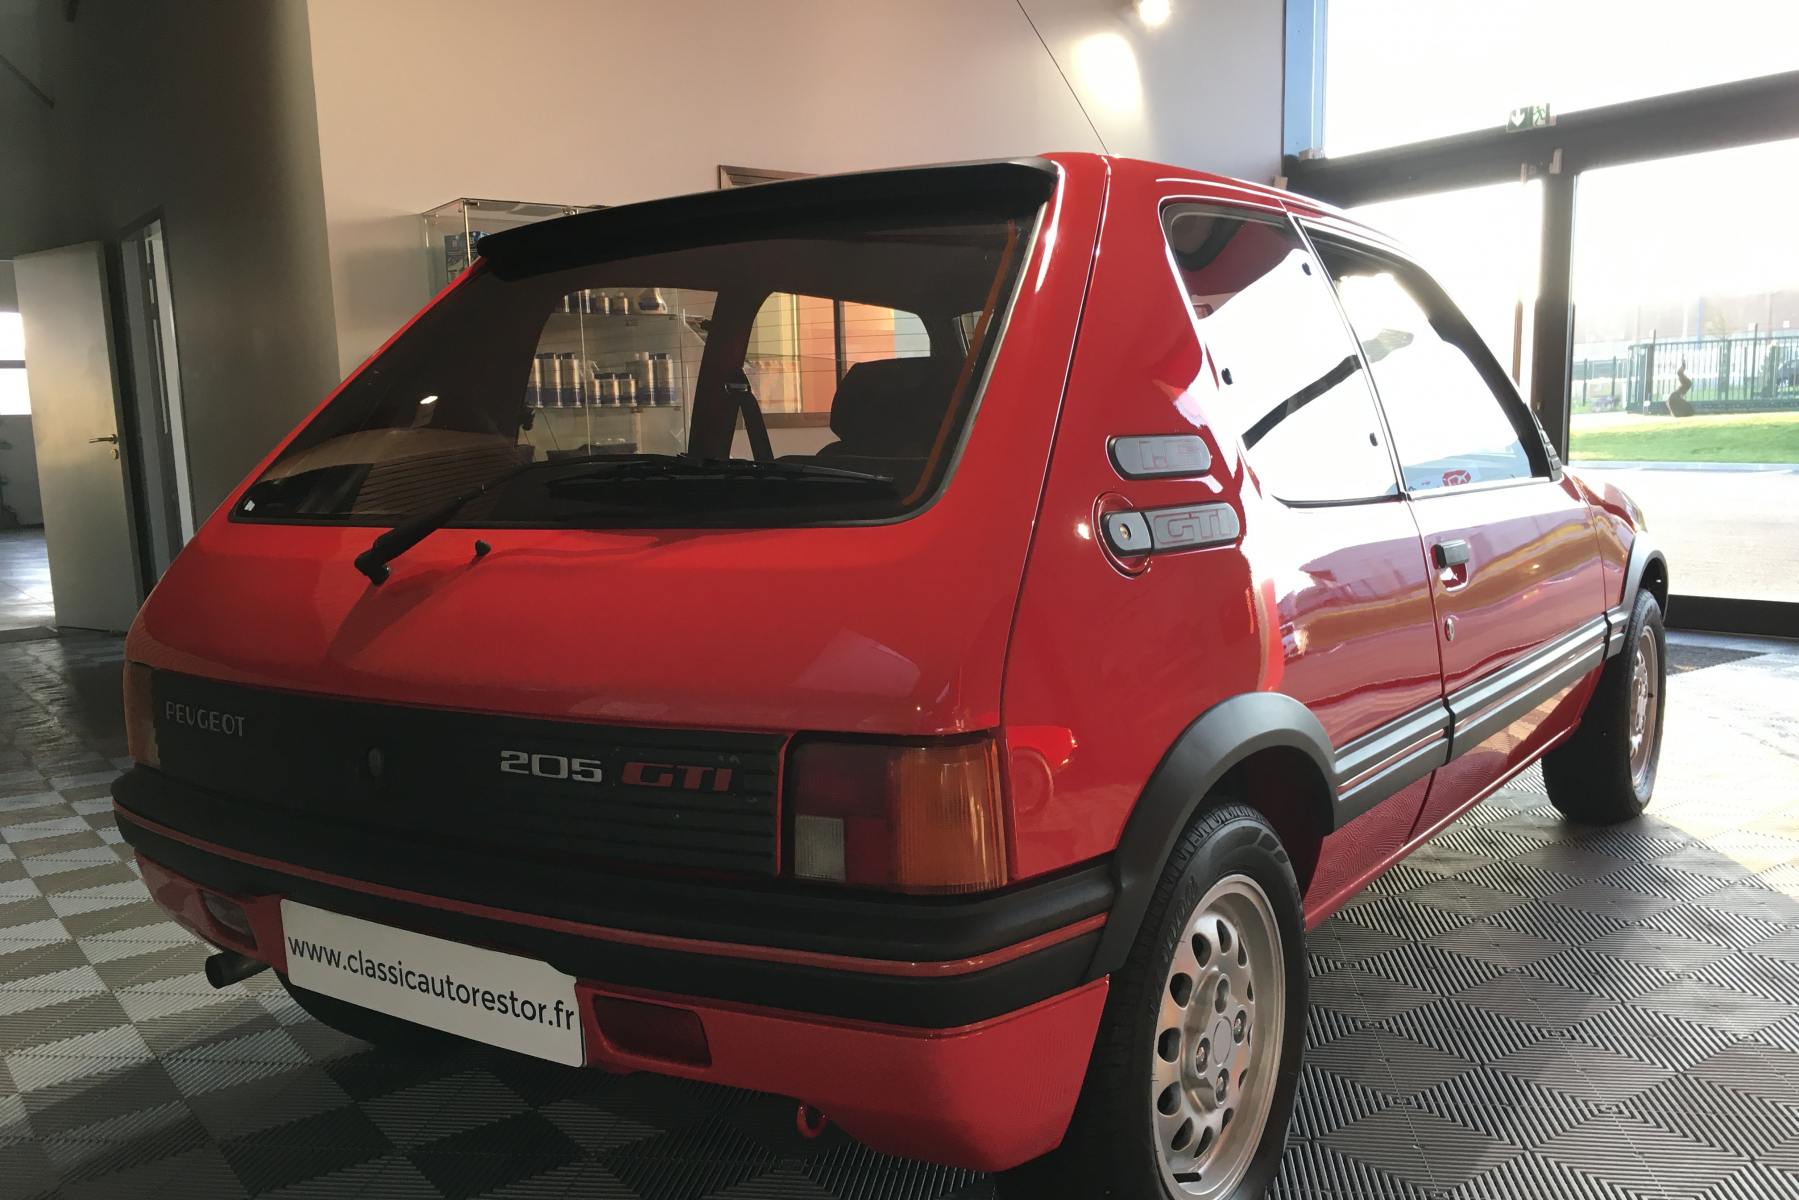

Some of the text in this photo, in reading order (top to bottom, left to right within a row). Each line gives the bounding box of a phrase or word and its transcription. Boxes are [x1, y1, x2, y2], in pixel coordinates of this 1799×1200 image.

[165, 700, 246, 737] PEUGEOT
[499, 750, 733, 792] 205 GTI
[287, 936, 575, 1030] www.classicautorestor.fr
